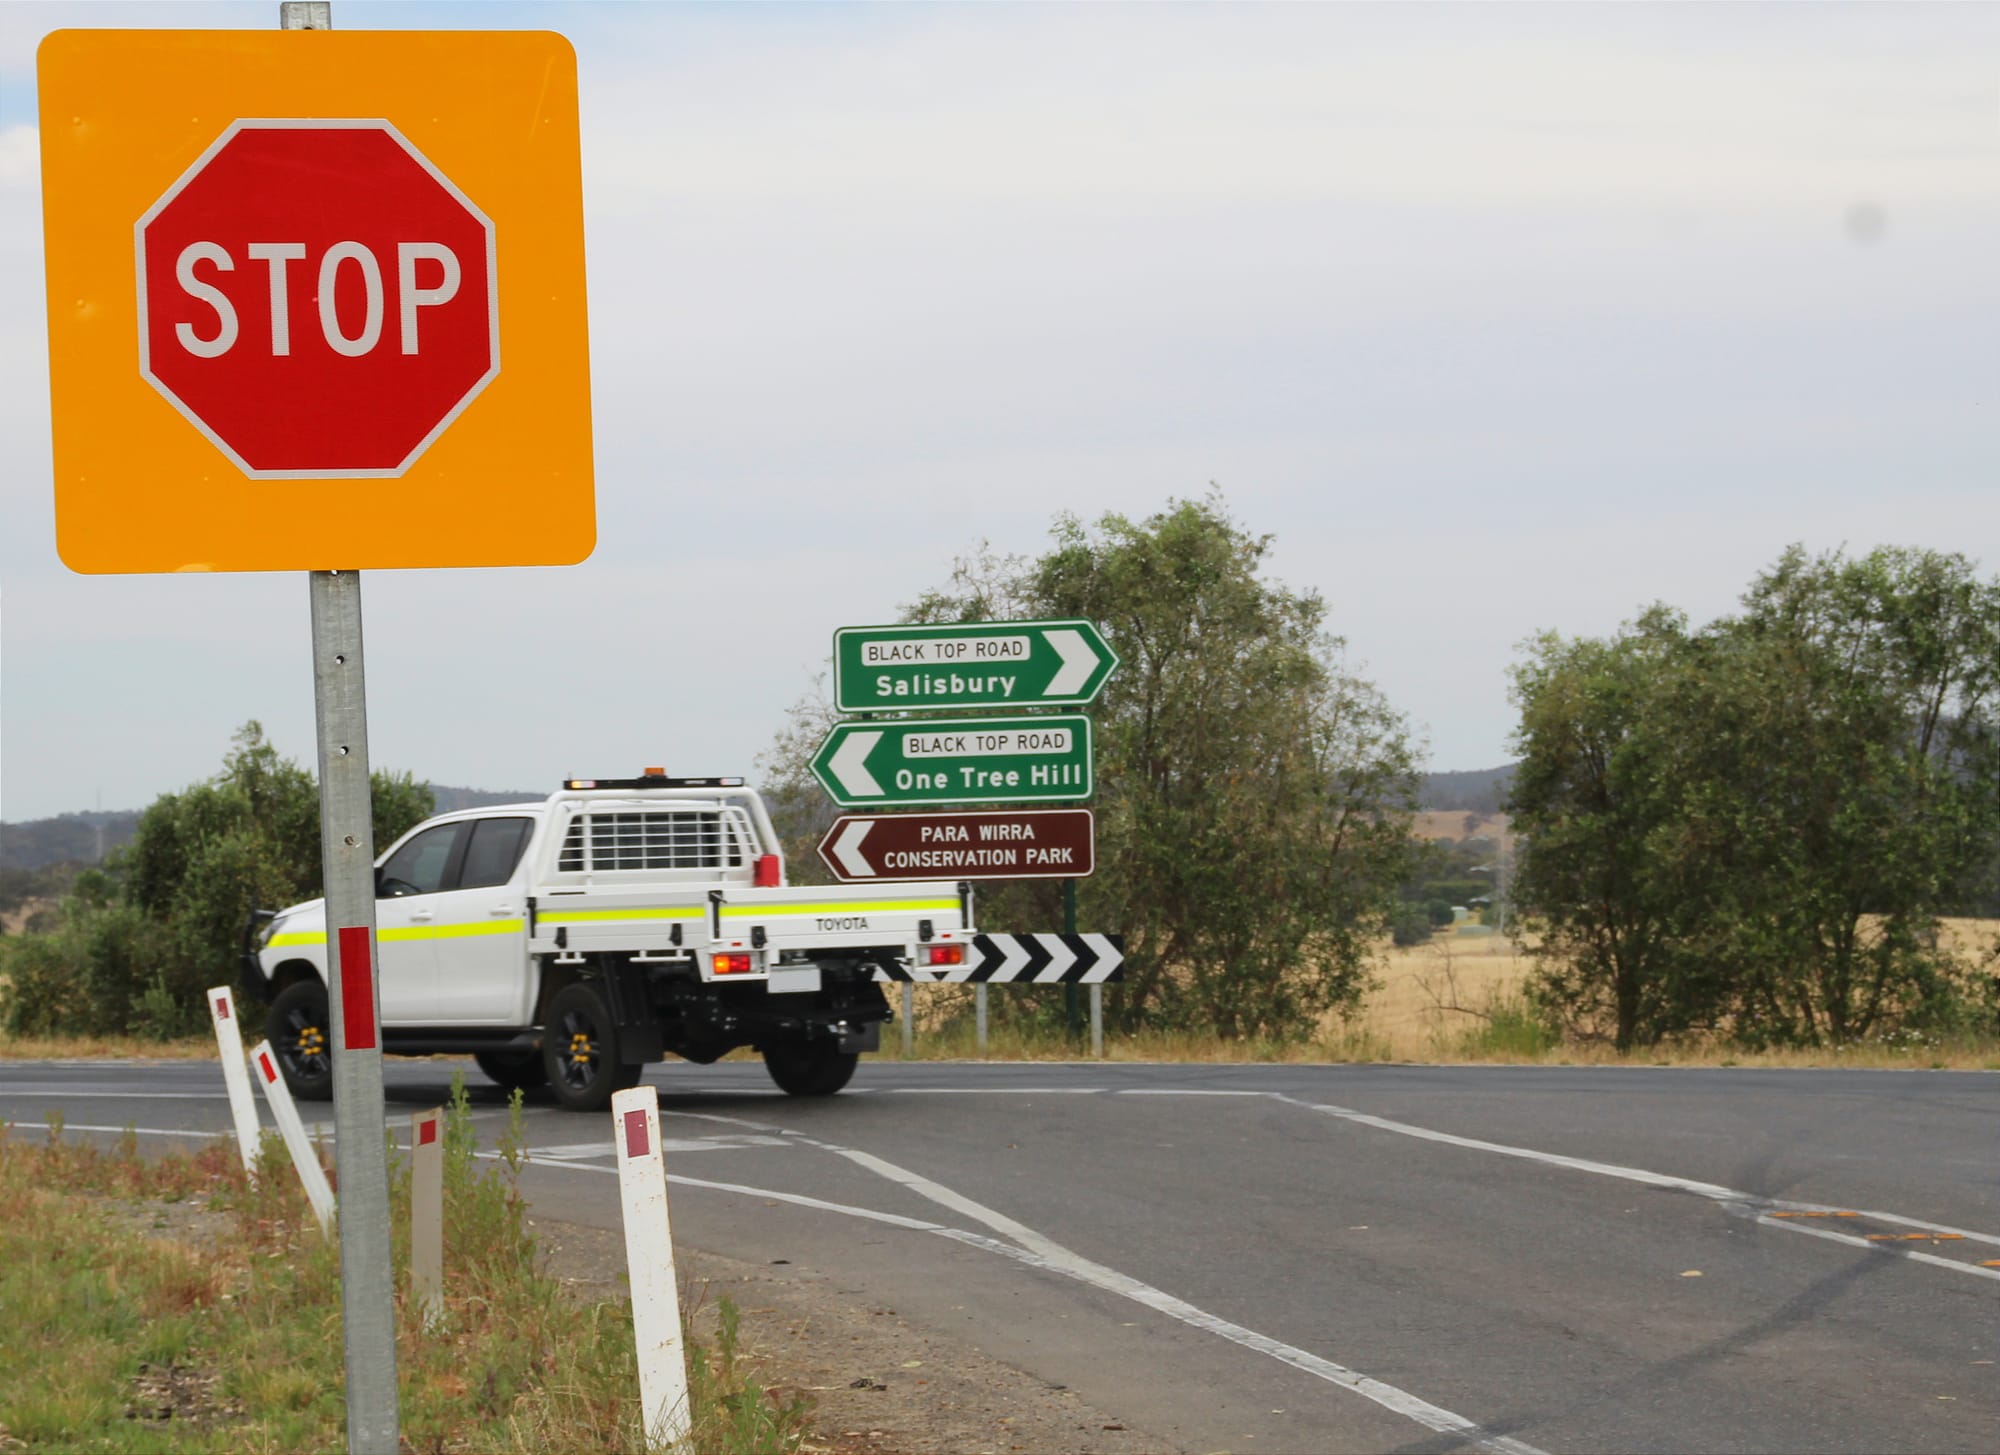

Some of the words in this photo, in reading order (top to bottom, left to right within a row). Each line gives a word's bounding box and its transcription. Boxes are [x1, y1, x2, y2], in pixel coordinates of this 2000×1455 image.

[175, 240, 462, 359] STOP
[868, 645, 924, 661] BLACK
[935, 643, 967, 659] TOP
[976, 641, 1024, 657] ROAD
[876, 673, 1016, 697] Salisbury
[909, 737, 966, 753] BLACK
[976, 735, 1008, 751] TOP
[1017, 733, 1065, 749] ROAD
[895, 768, 948, 790] One
[959, 766, 1020, 788] Tree
[1031, 764, 1081, 785] Hill
[921, 826, 969, 842] PARA
[979, 824, 1035, 840] WIRRA
[884, 849, 1016, 868] CONSERVATION
[1026, 848, 1073, 864] PARK
[816, 917, 868, 931] TOYOTA
